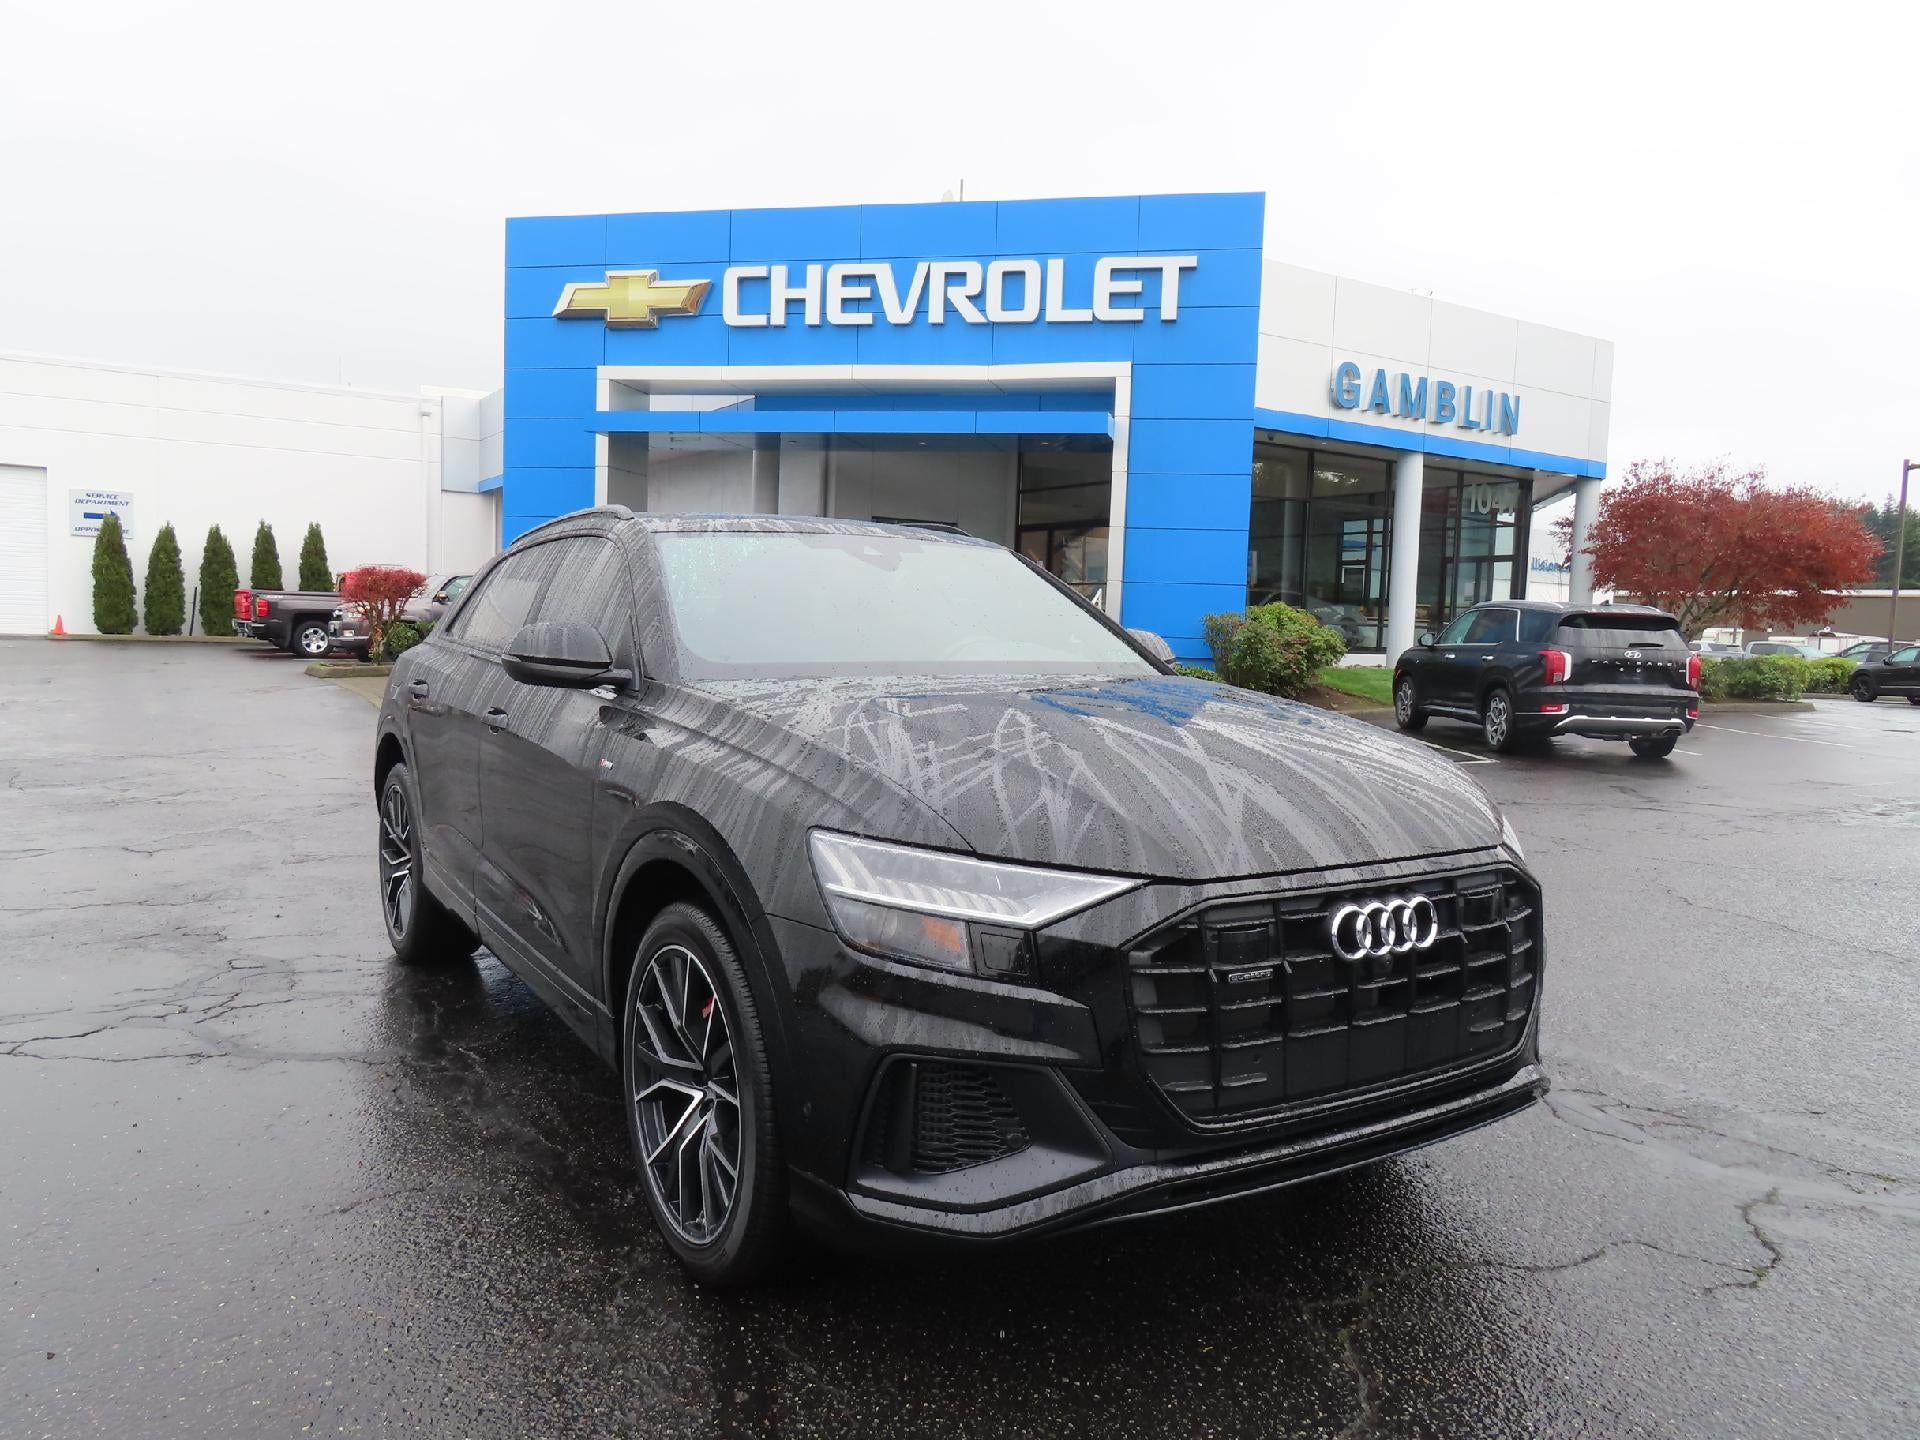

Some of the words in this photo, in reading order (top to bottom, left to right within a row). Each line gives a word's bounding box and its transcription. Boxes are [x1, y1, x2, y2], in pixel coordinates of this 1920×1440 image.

[722, 255, 1198, 328] CHEVROLET
[1333, 361, 1521, 436] GAMBLIN
[85, 492, 119, 500] SERVICE
